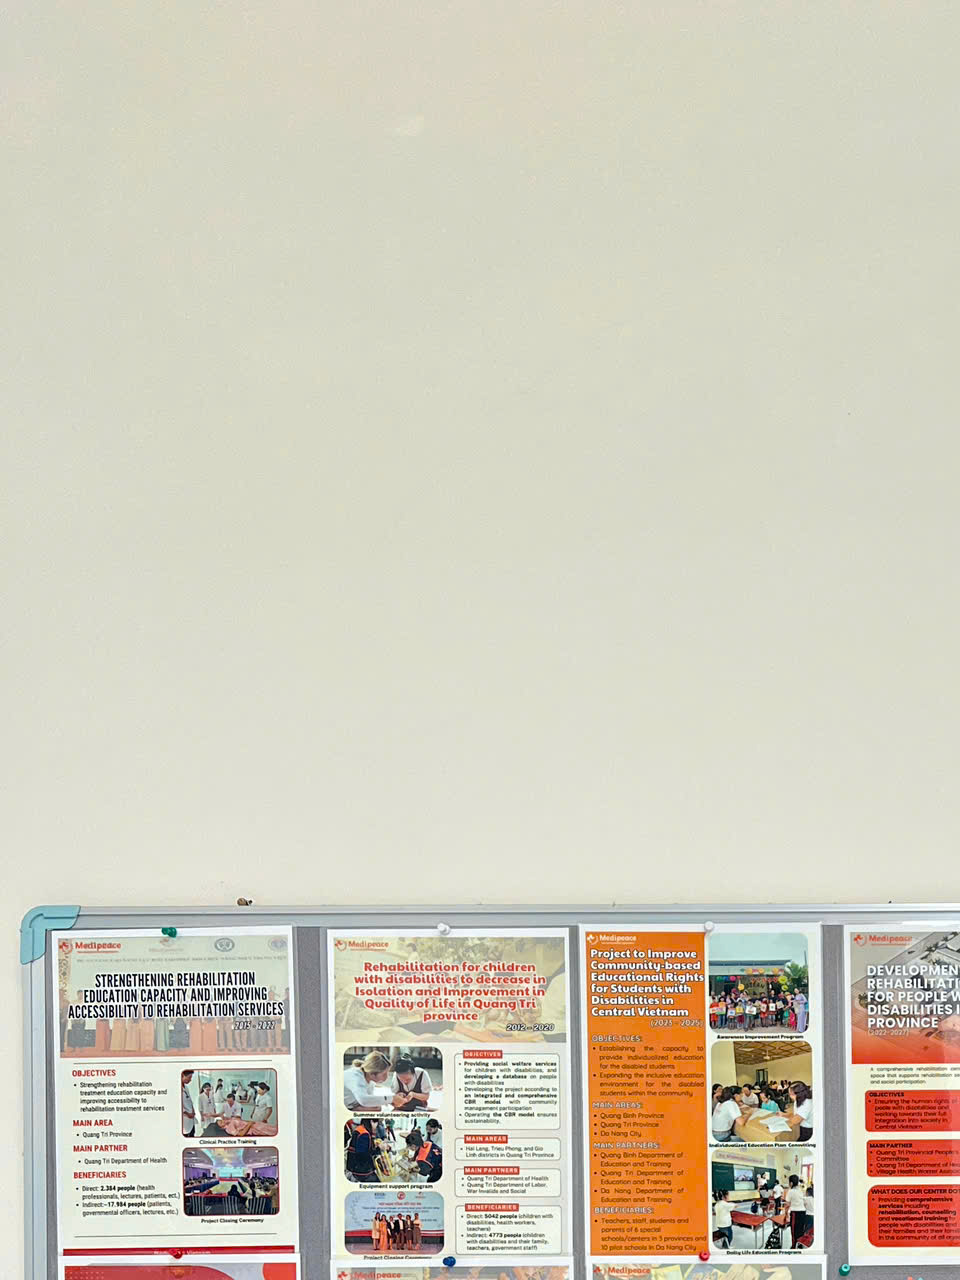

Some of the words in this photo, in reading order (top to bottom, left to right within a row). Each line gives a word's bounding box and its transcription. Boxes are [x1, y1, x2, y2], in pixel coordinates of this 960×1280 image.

[869, 935, 912, 943] Medipeace
[75, 941, 121, 951] Medipeace
[348, 941, 389, 949] Medipeace
[590, 950, 631, 960] Project
[633, 950, 645, 959] to
[648, 950, 696, 960] Improve
[364, 962, 459, 972] Rehabilitation
[462, 962, 480, 972] for
[483, 962, 536, 972] children
[591, 961, 700, 972] Community-based
[95, 973, 173, 988] STRENGTHENING
[177, 972, 255, 986] REHABILITATION
[354, 975, 382, 984] with
[385, 974, 457, 984] disabilities
[460, 975, 473, 984] to
[476, 974, 530, 984] decrease
[533, 975, 546, 984] in
[591, 973, 663, 982] Educational
[666, 973, 704, 983] Rights
[355, 986, 412, 996] Isolation
[415, 986, 441, 996] and
[443, 986, 530, 998] Improvement
[533, 986, 545, 996] in
[591, 984, 609, 993] for
[611, 984, 662, 993] Students
[664, 984, 691, 993] with
[84, 990, 137, 1004] EDUCATION
[141, 988, 187, 1002] CAPACITY
[191, 988, 210, 1001] AND
[213, 987, 267, 1001] IMPROVING
[591, 995, 659, 1005] Disabilities
[662, 995, 674, 1005] in
[867, 991, 894, 1002] FOR
[898, 991, 947, 1002] PEOPLE
[365, 999, 414, 1011] Quality
[416, 998, 430, 1009] of
[432, 999, 455, 1009] Life
[458, 999, 471, 1009] in
[473, 999, 516, 1010] Quang
[519, 999, 536, 1009] Tri
[68, 1004, 138, 1019] ACCESSIBILITY
[142, 1004, 154, 1017] TO
[157, 1002, 235, 1017] REHABILITATION
[238, 1002, 284, 1016] SERVICES
[591, 1007, 635, 1017] Central
[638, 1007, 689, 1017] Vietnam
[867, 1004, 953, 1016] DISABILITIES
[423, 1011, 478, 1022] province
[867, 1017, 938, 1028] PROVINCE
[600, 1112, 621, 1120] Quang
[73, 1171, 127, 1179] BENEFICIARIES
[608, 1266, 650, 1275] Medipeace
